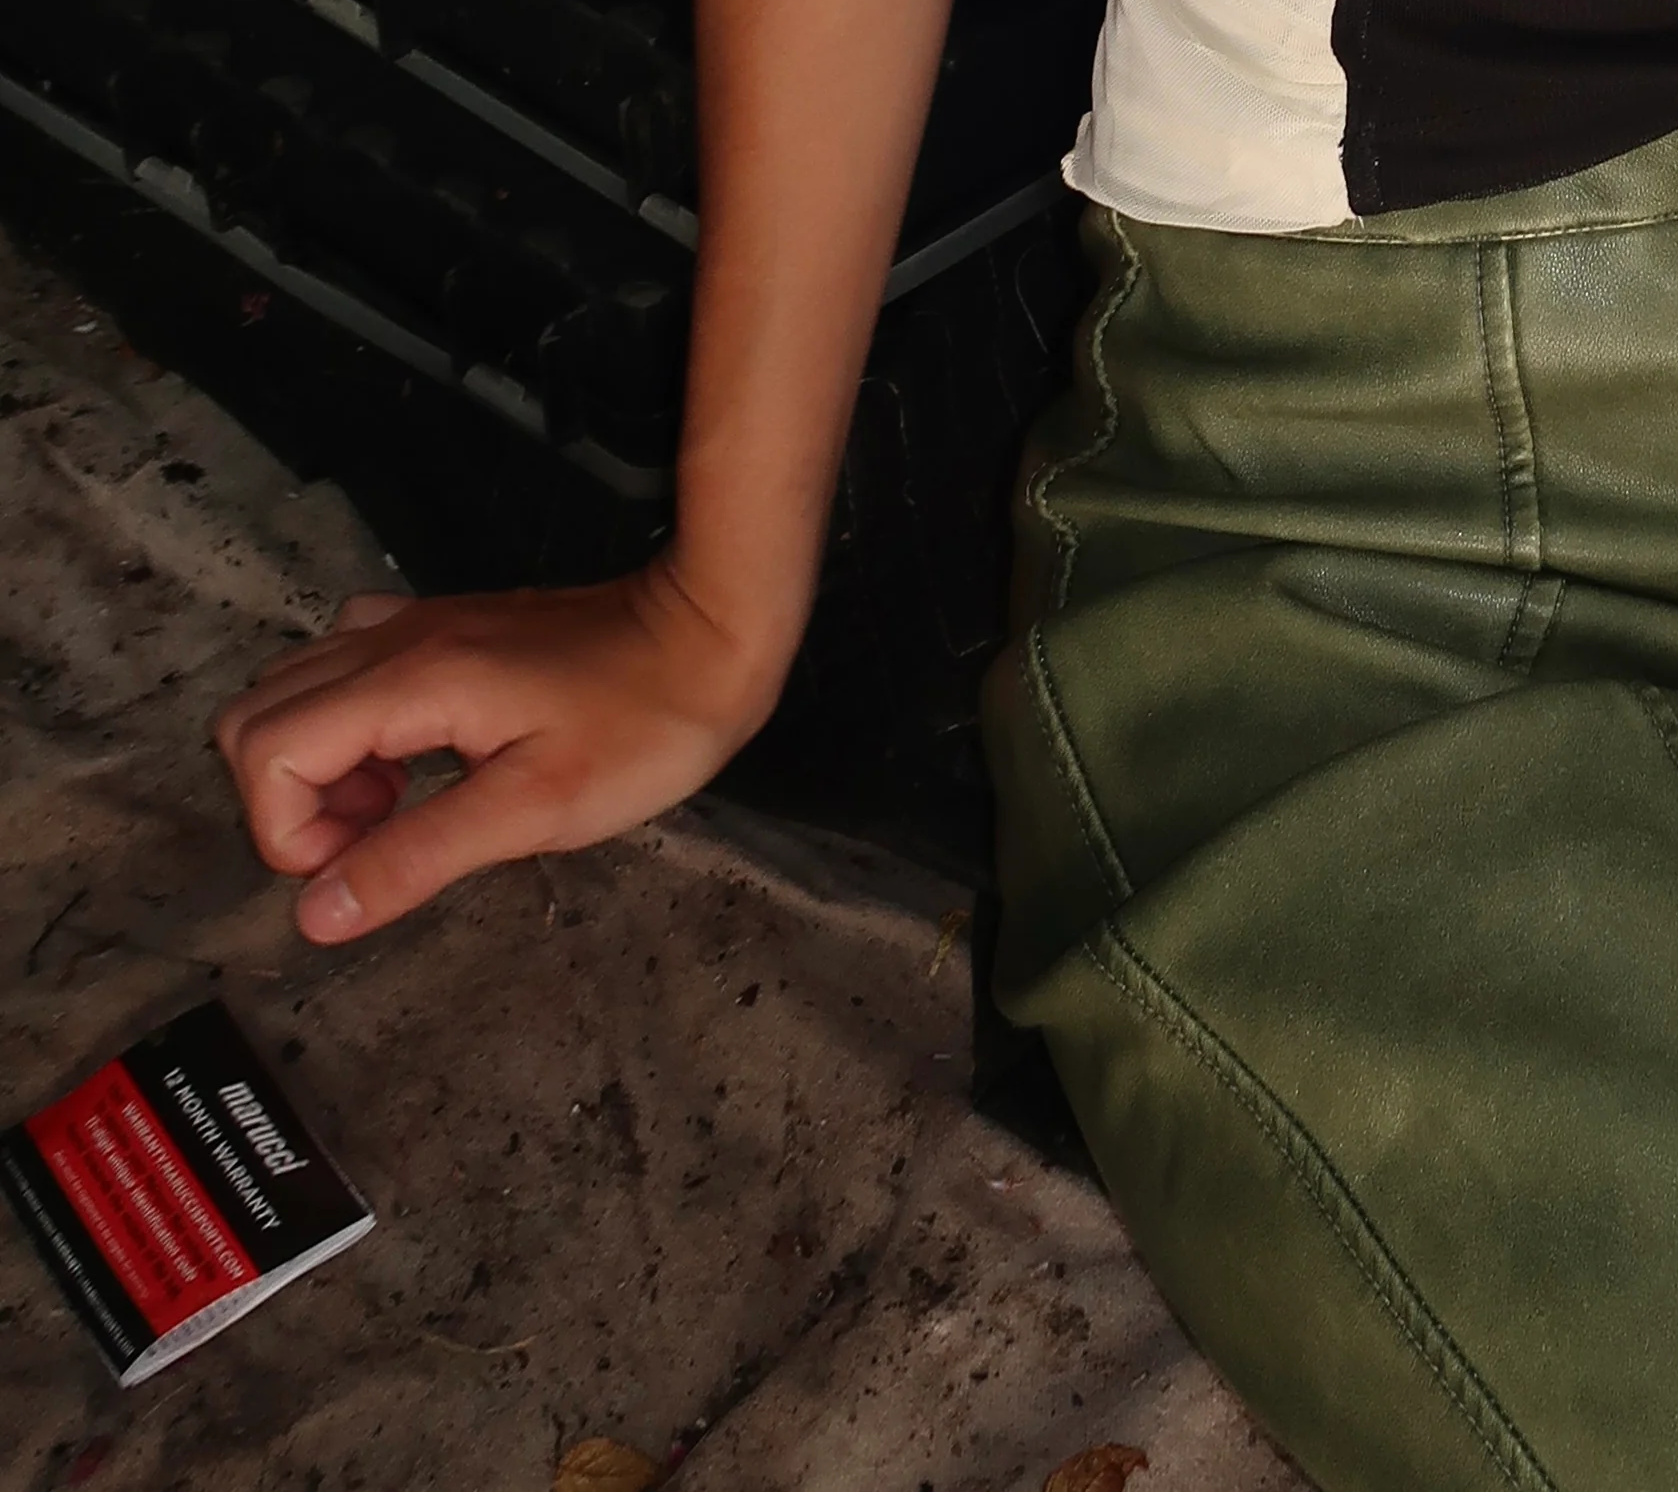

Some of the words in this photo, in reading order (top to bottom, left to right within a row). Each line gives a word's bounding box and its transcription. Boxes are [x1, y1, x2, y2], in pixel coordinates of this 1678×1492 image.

[163, 1067, 185, 1089] 12
[174, 1084, 222, 1144] MONTH
[211, 1140, 281, 1231] WARRANTY
[217, 1080, 310, 1176] marucci
